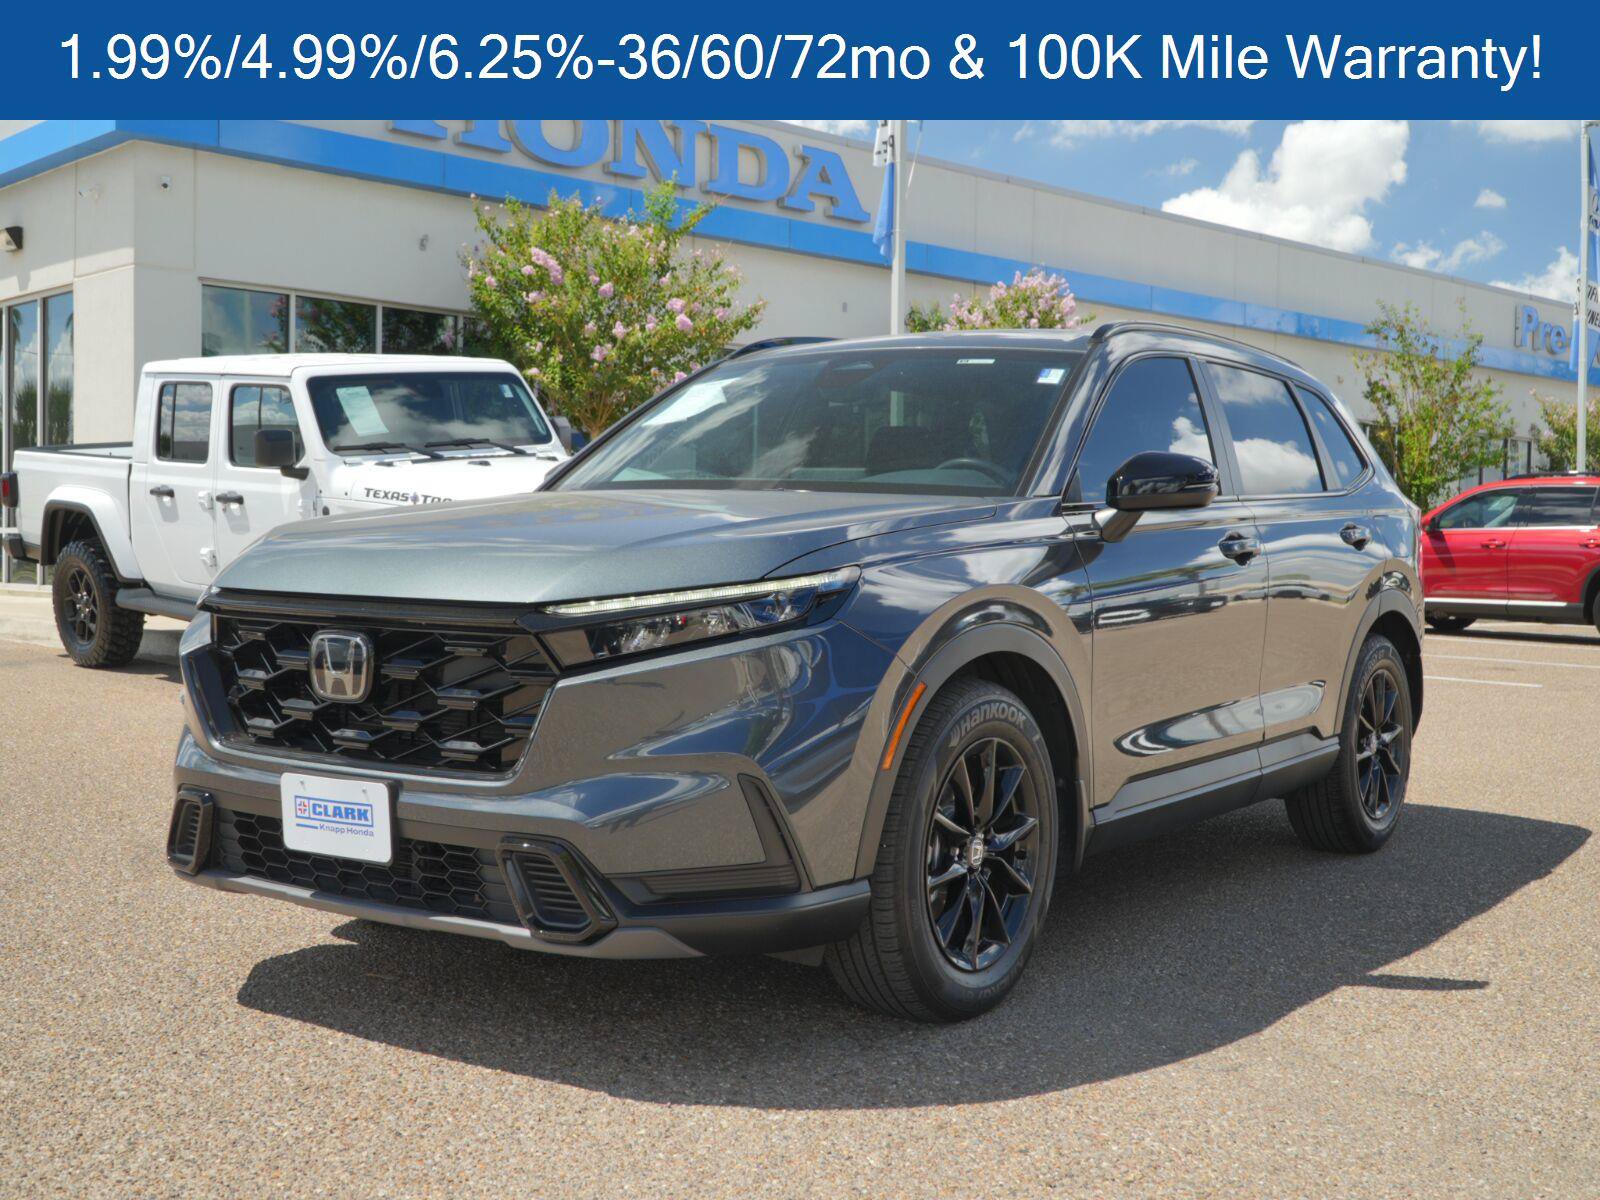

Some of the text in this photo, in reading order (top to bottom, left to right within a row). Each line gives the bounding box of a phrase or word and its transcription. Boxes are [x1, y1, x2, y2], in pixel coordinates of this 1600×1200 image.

[388, 119, 870, 223] ONDA
[1515, 304, 1572, 354] Pre
[364, 487, 409, 502] TEXAS
[311, 803, 369, 822] CLARK
[319, 823, 374, 837] Knapp Honda
